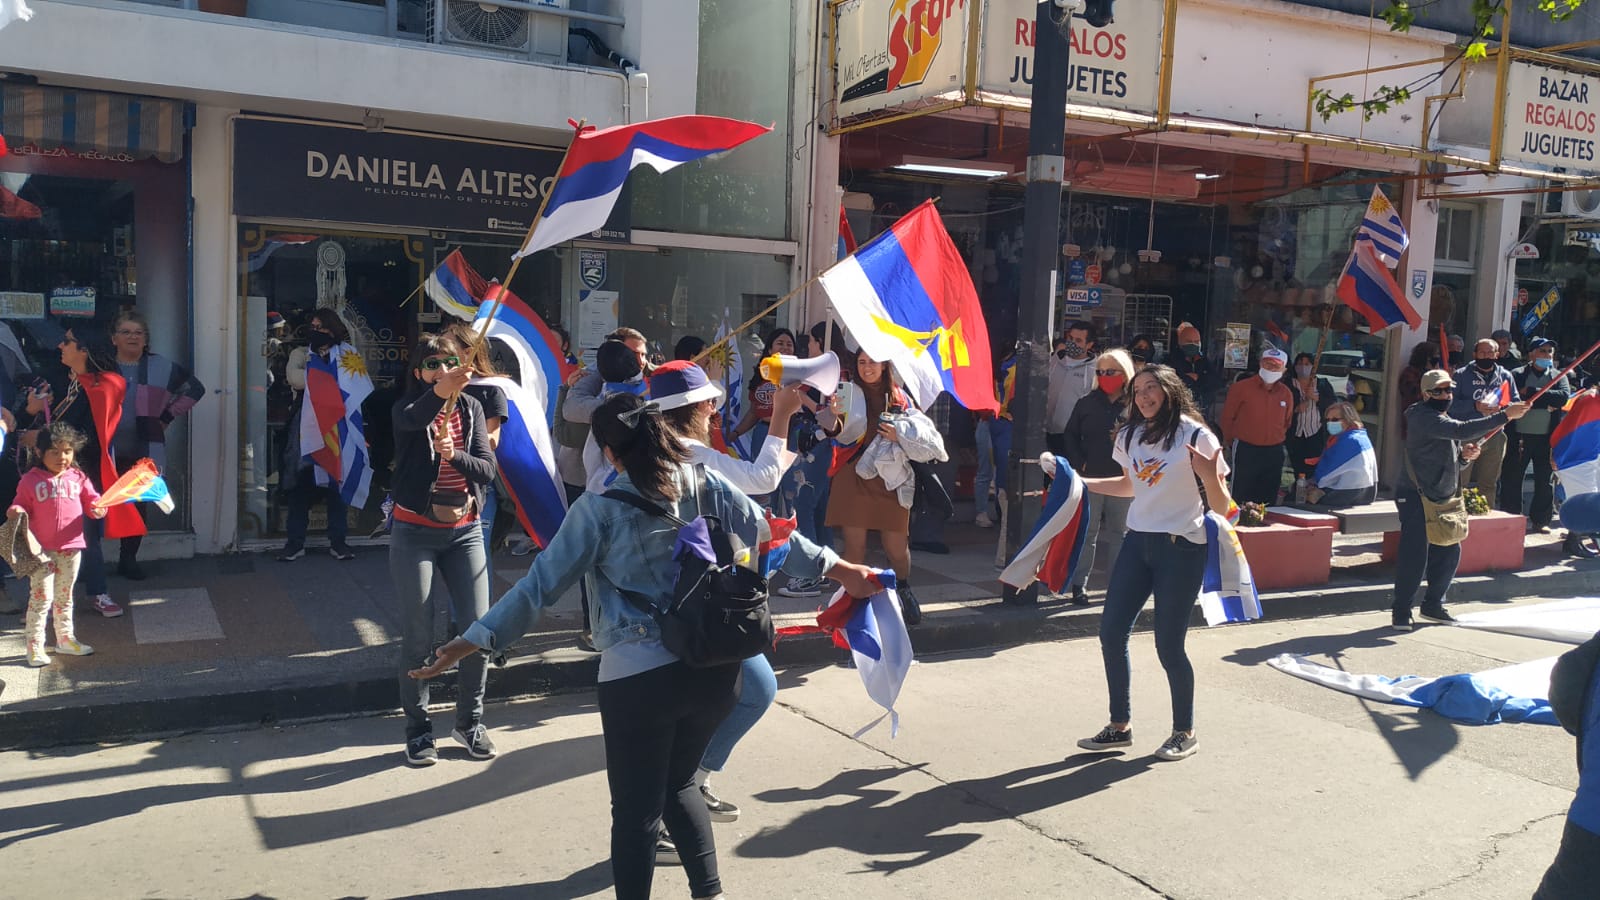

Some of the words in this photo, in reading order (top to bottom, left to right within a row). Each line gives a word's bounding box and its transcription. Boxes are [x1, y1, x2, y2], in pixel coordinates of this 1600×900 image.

[886, 0, 964, 94] STO
[1015, 18, 1127, 61] RALOS
[856, 48, 887, 77] Ofertas
[1009, 55, 1128, 98] JUUETES
[1539, 76, 1588, 104] BAZAR
[1525, 102, 1596, 134] REGALOS
[1521, 131, 1594, 161] JUGUETES
[306, 150, 447, 190] DANIELA
[1069, 290, 1088, 301] VISA
[34, 478, 80, 503] GAP
